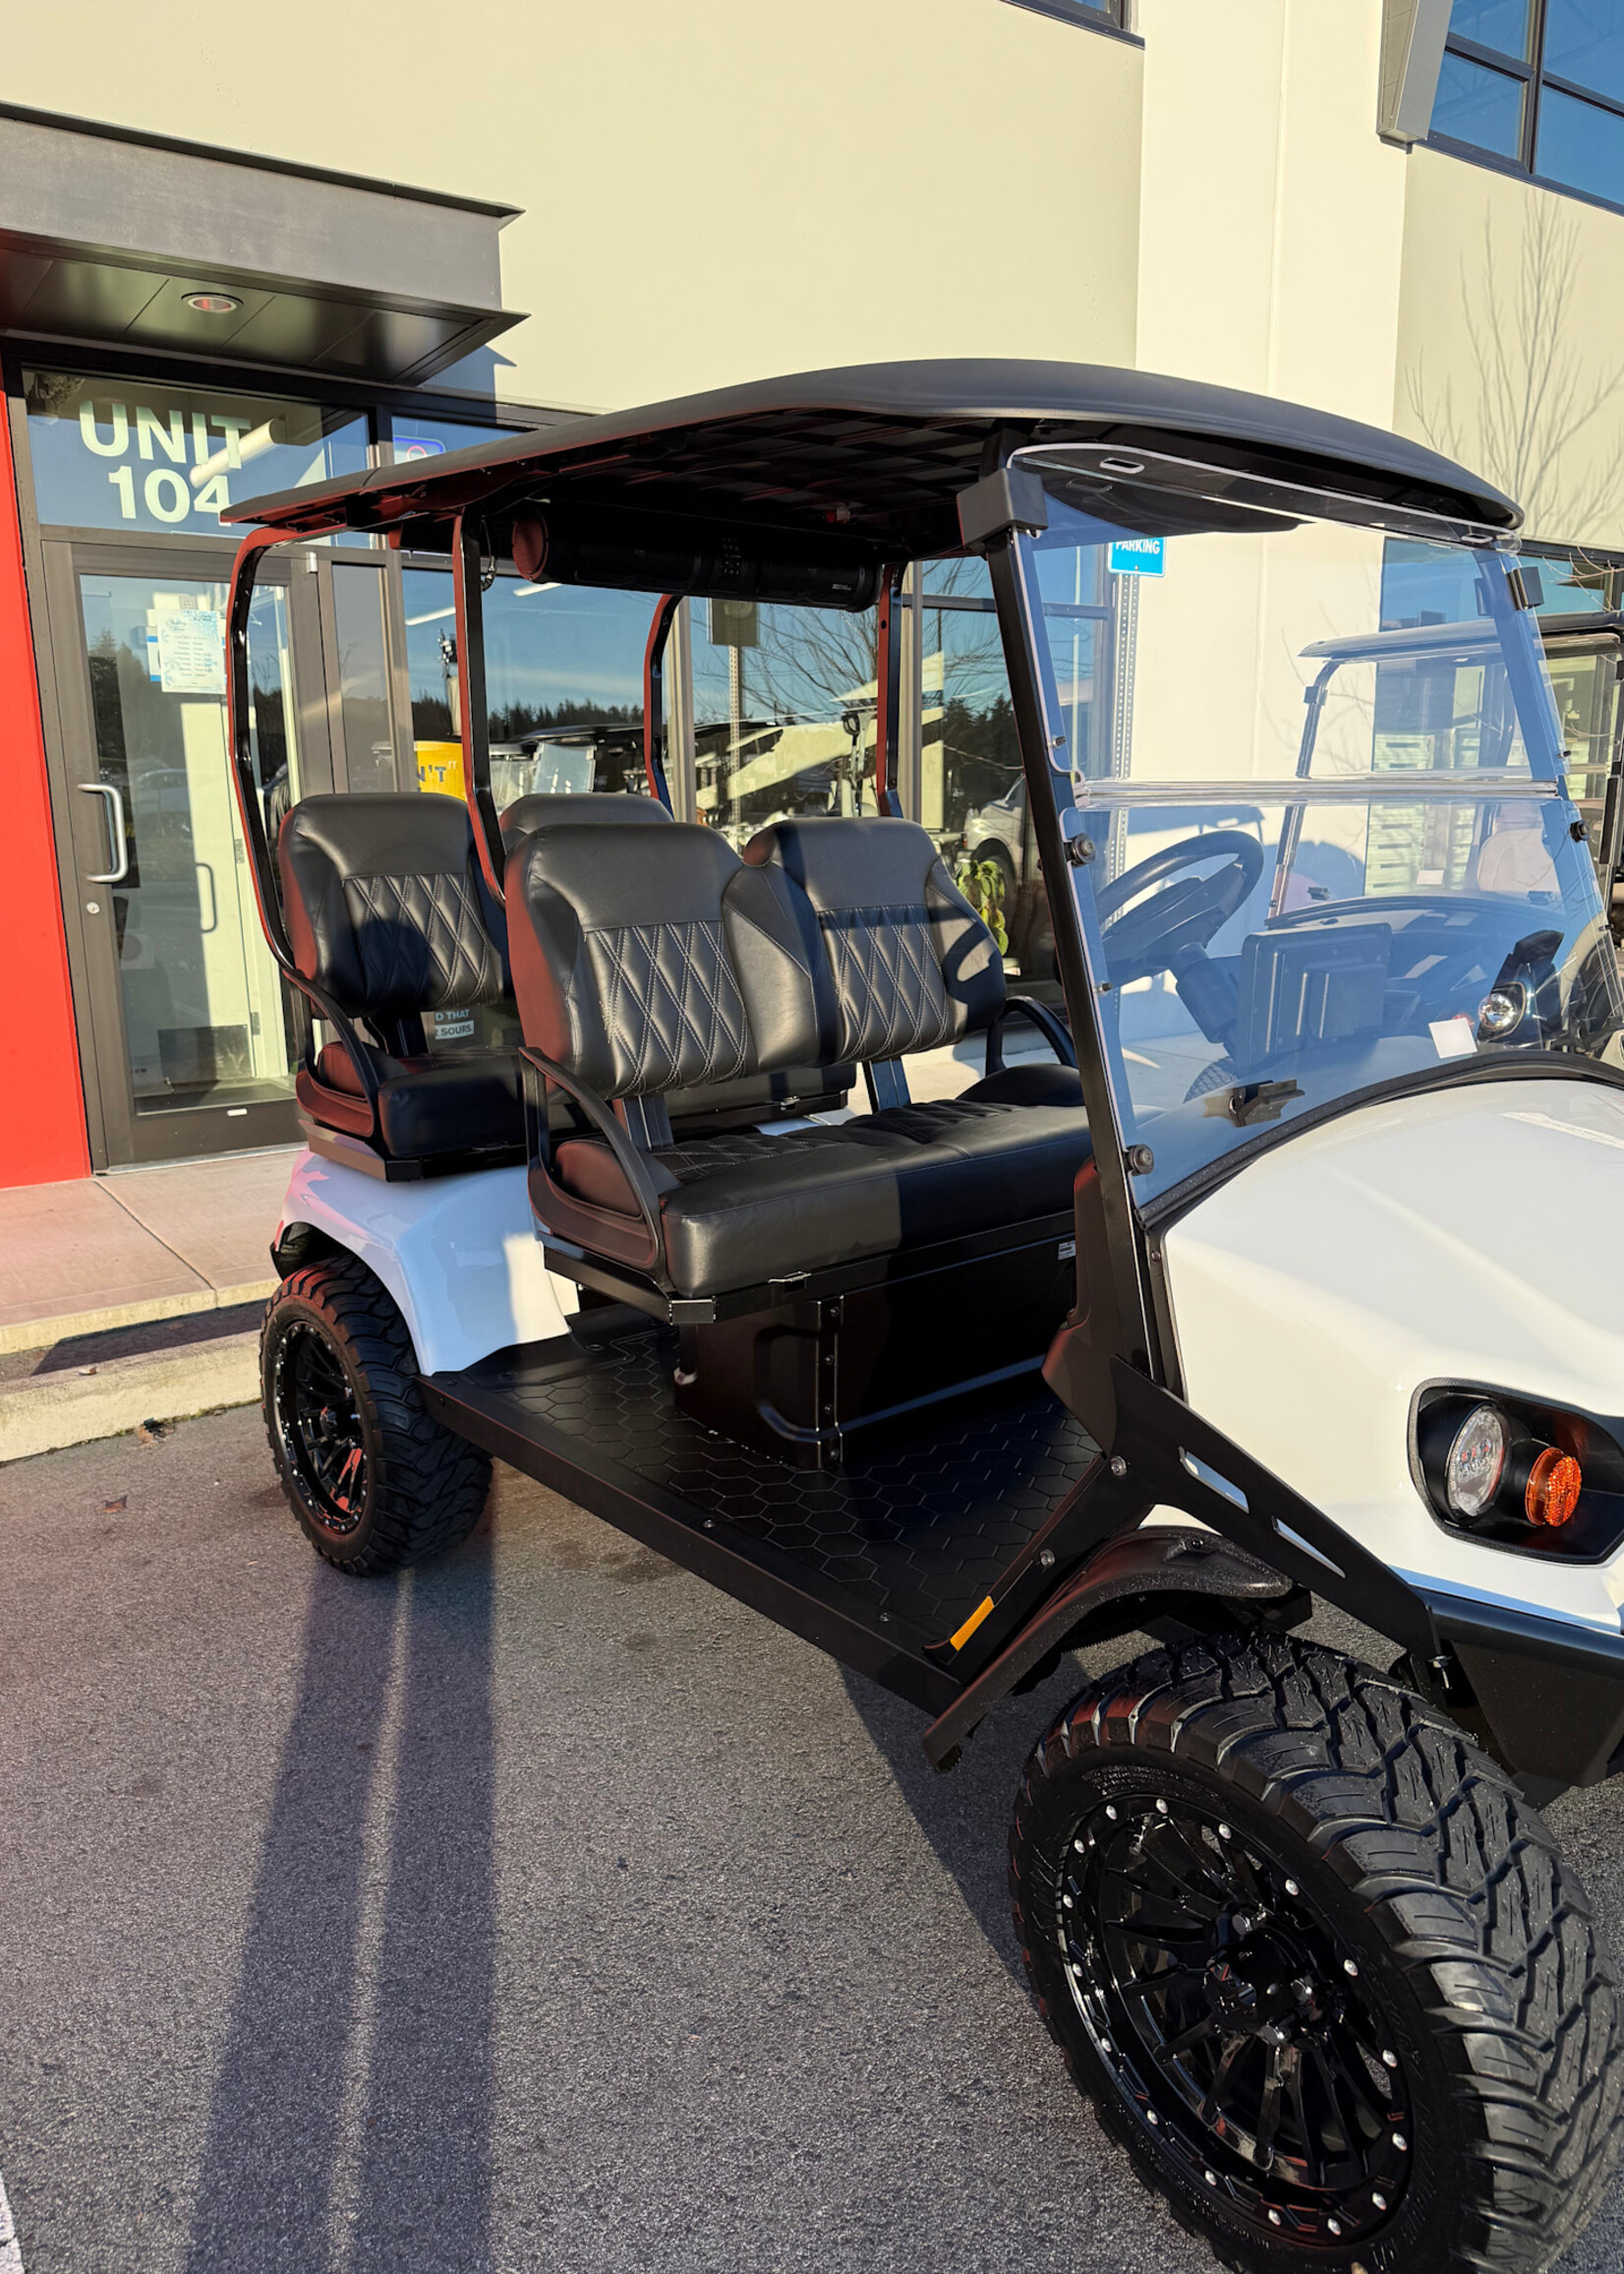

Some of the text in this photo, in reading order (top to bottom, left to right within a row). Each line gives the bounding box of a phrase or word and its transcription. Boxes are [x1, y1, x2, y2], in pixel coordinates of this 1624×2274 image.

[80, 401, 252, 469] UNIT
[108, 465, 233, 527] 104
[1116, 539, 1161, 554] PARKING
[446, 1009, 470, 1020] THAT
[440, 1023, 473, 1037] SOURS
